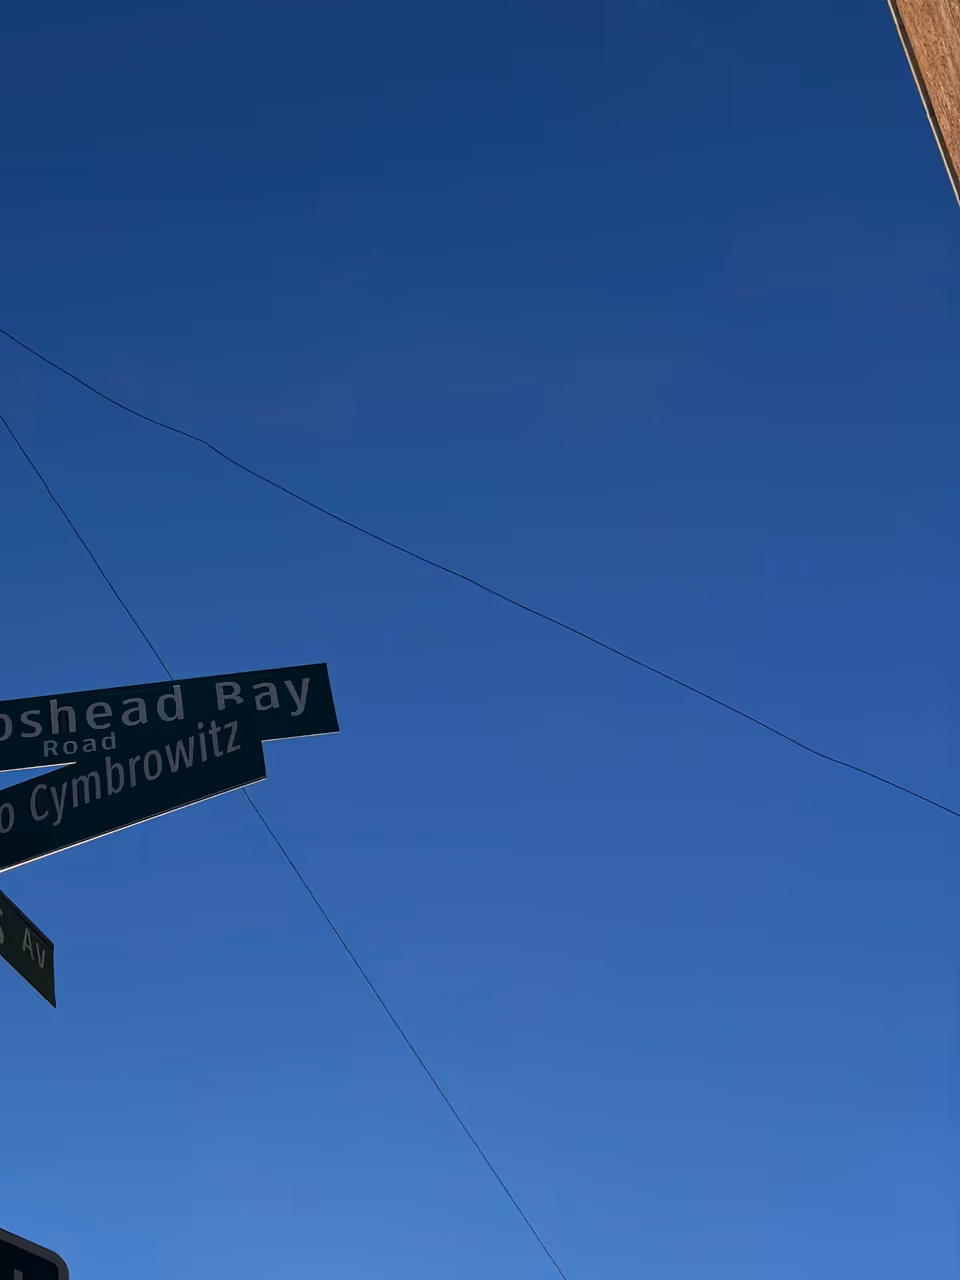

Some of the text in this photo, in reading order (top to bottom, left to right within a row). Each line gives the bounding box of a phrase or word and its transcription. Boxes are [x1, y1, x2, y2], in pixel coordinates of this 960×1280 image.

[43, 731, 116, 757] Road
[30, 719, 242, 827] Cymbrowitz
[21, 928, 46, 970] Av
